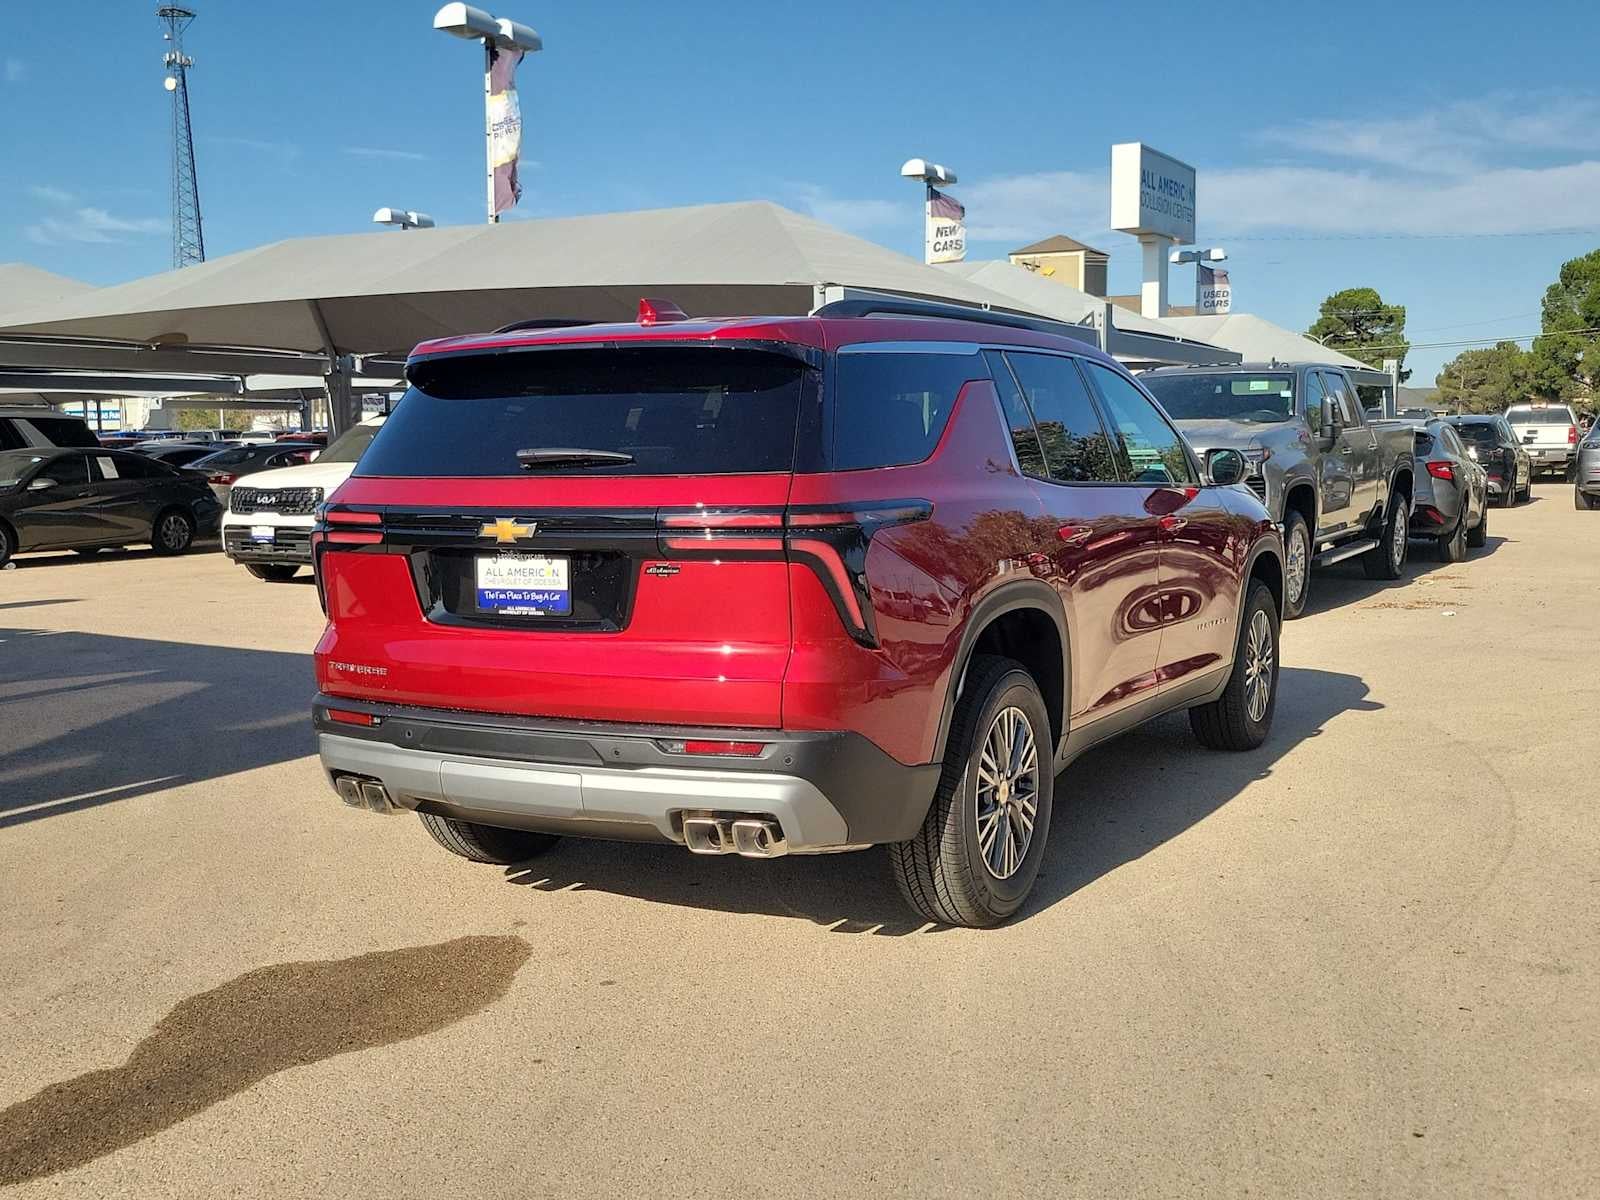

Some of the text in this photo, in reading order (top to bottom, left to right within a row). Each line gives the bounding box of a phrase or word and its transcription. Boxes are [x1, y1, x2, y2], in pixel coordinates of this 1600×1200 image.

[1142, 169, 1195, 203] ALL AMERICN
[935, 225, 960, 239] NEW
[932, 239, 963, 253] CARS
[1203, 290, 1229, 299] USED
[1203, 300, 1229, 309] CARS
[485, 567, 559, 577] ALL AMERICN
[484, 590, 495, 600] The
[495, 590, 506, 600] Fun
[506, 590, 522, 600] Place
[522, 591, 531, 600] To
[531, 592, 544, 603] Buy
[550, 592, 560, 600] Car
